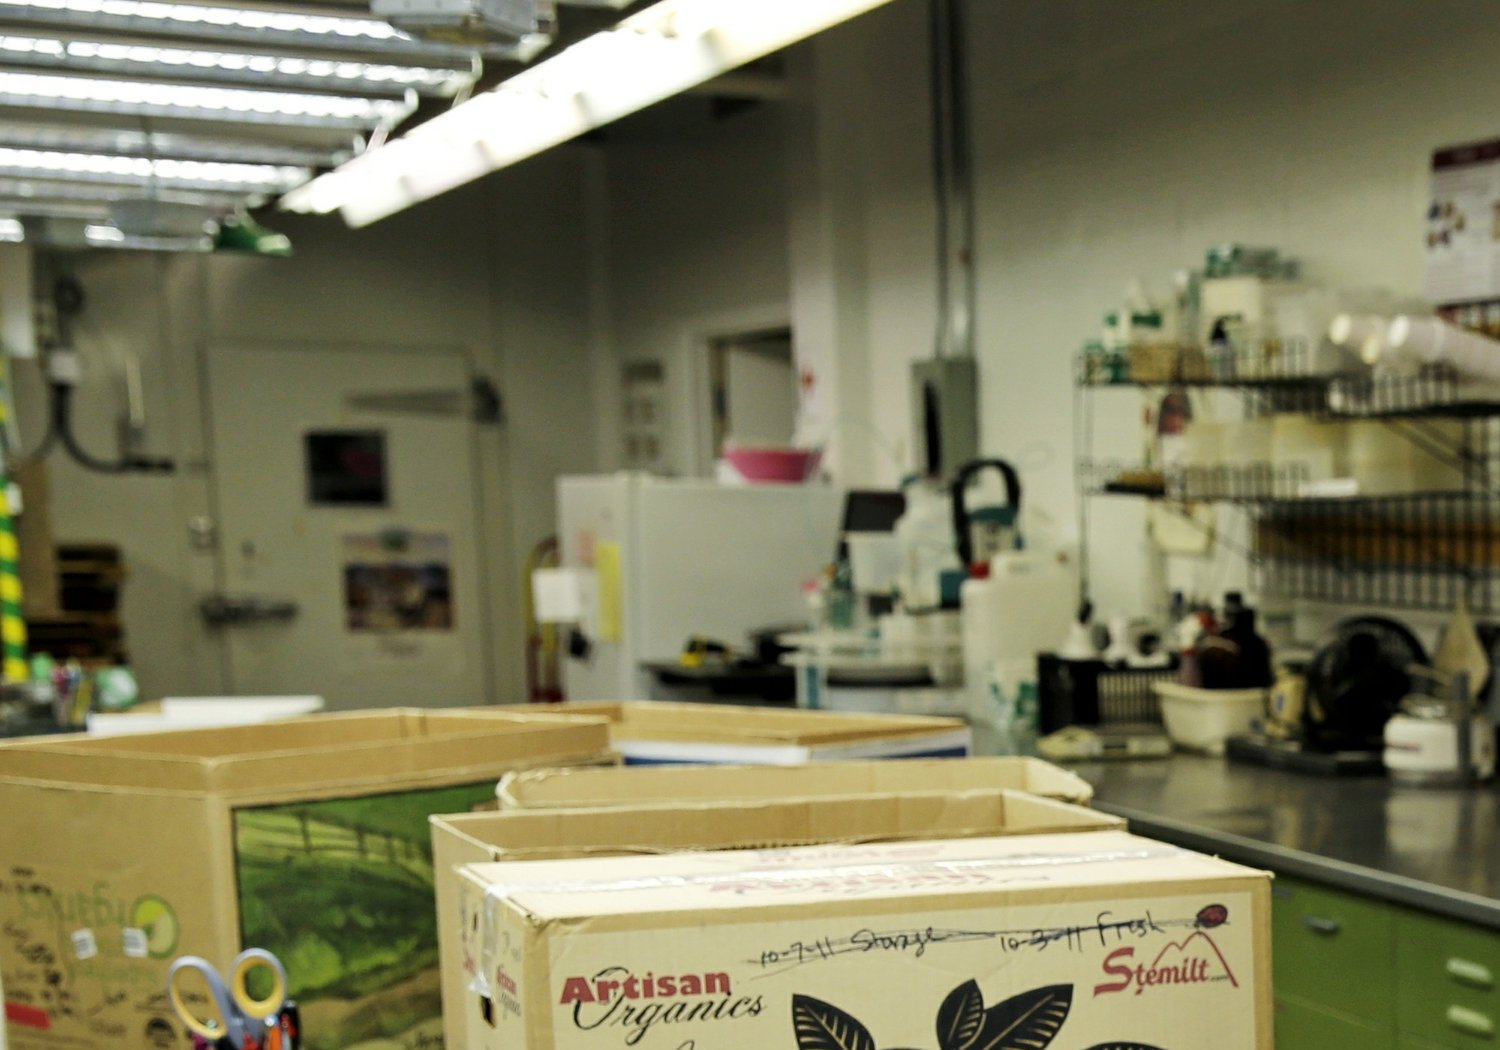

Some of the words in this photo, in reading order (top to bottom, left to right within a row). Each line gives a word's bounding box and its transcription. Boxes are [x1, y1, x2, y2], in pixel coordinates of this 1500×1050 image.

[559, 972, 732, 1004] Artisan
[1093, 946, 1210, 997] Stemilt
[573, 966, 766, 1046] Organics
